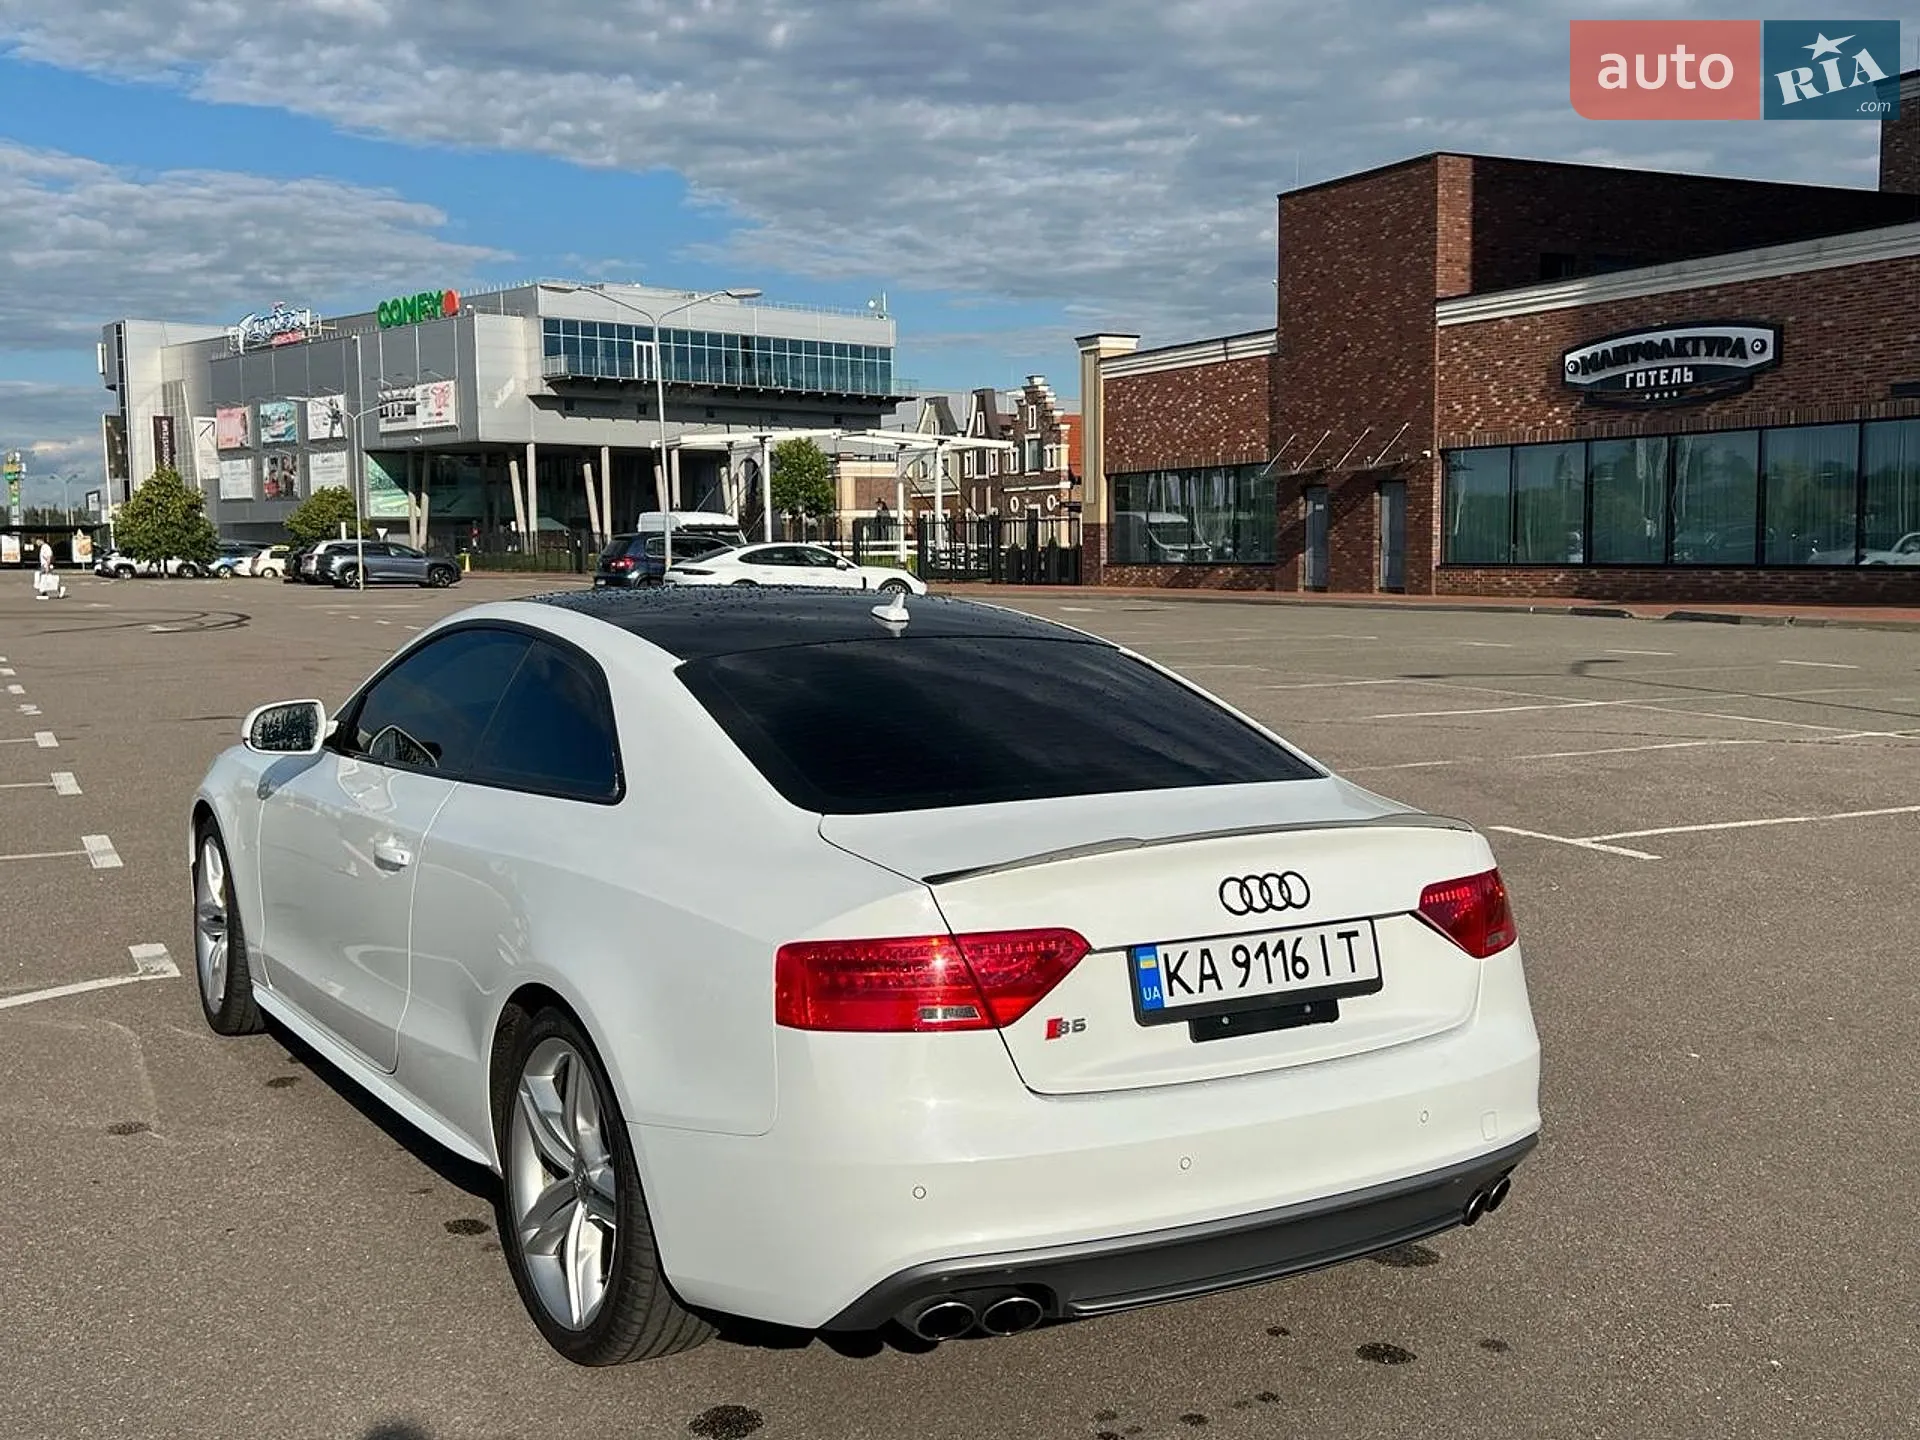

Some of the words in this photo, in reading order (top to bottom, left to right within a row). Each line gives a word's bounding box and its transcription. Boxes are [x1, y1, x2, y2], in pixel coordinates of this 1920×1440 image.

[378, 290, 443, 328] COMFY
[1580, 336, 1748, 375] МАНУФАКТУРА
[1625, 366, 1693, 388] ГОТЕЛЬ
[1163, 948, 1223, 997] KA
[1231, 936, 1309, 988] 9116
[1143, 986, 1162, 1001] UA
